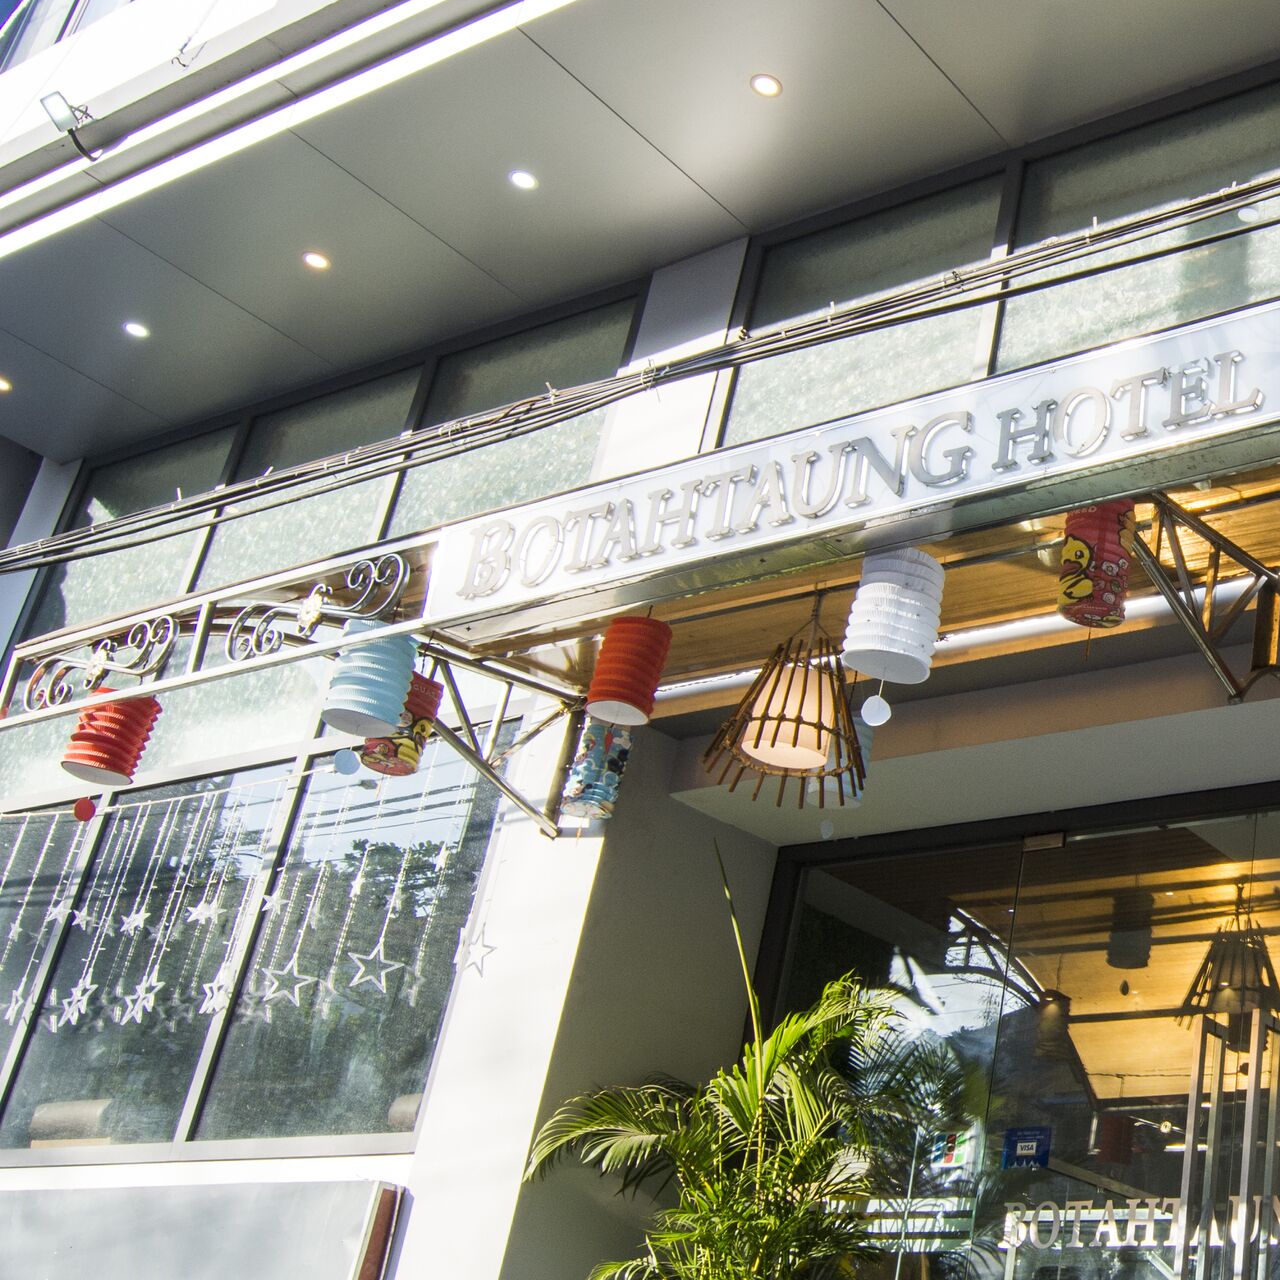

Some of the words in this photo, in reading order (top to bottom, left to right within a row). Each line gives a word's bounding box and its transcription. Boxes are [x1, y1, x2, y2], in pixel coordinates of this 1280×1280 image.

[456, 410, 975, 600] BOTAHTAUNG
[991, 349, 1266, 473] HOTEL
[1020, 1144, 1034, 1152] VISA
